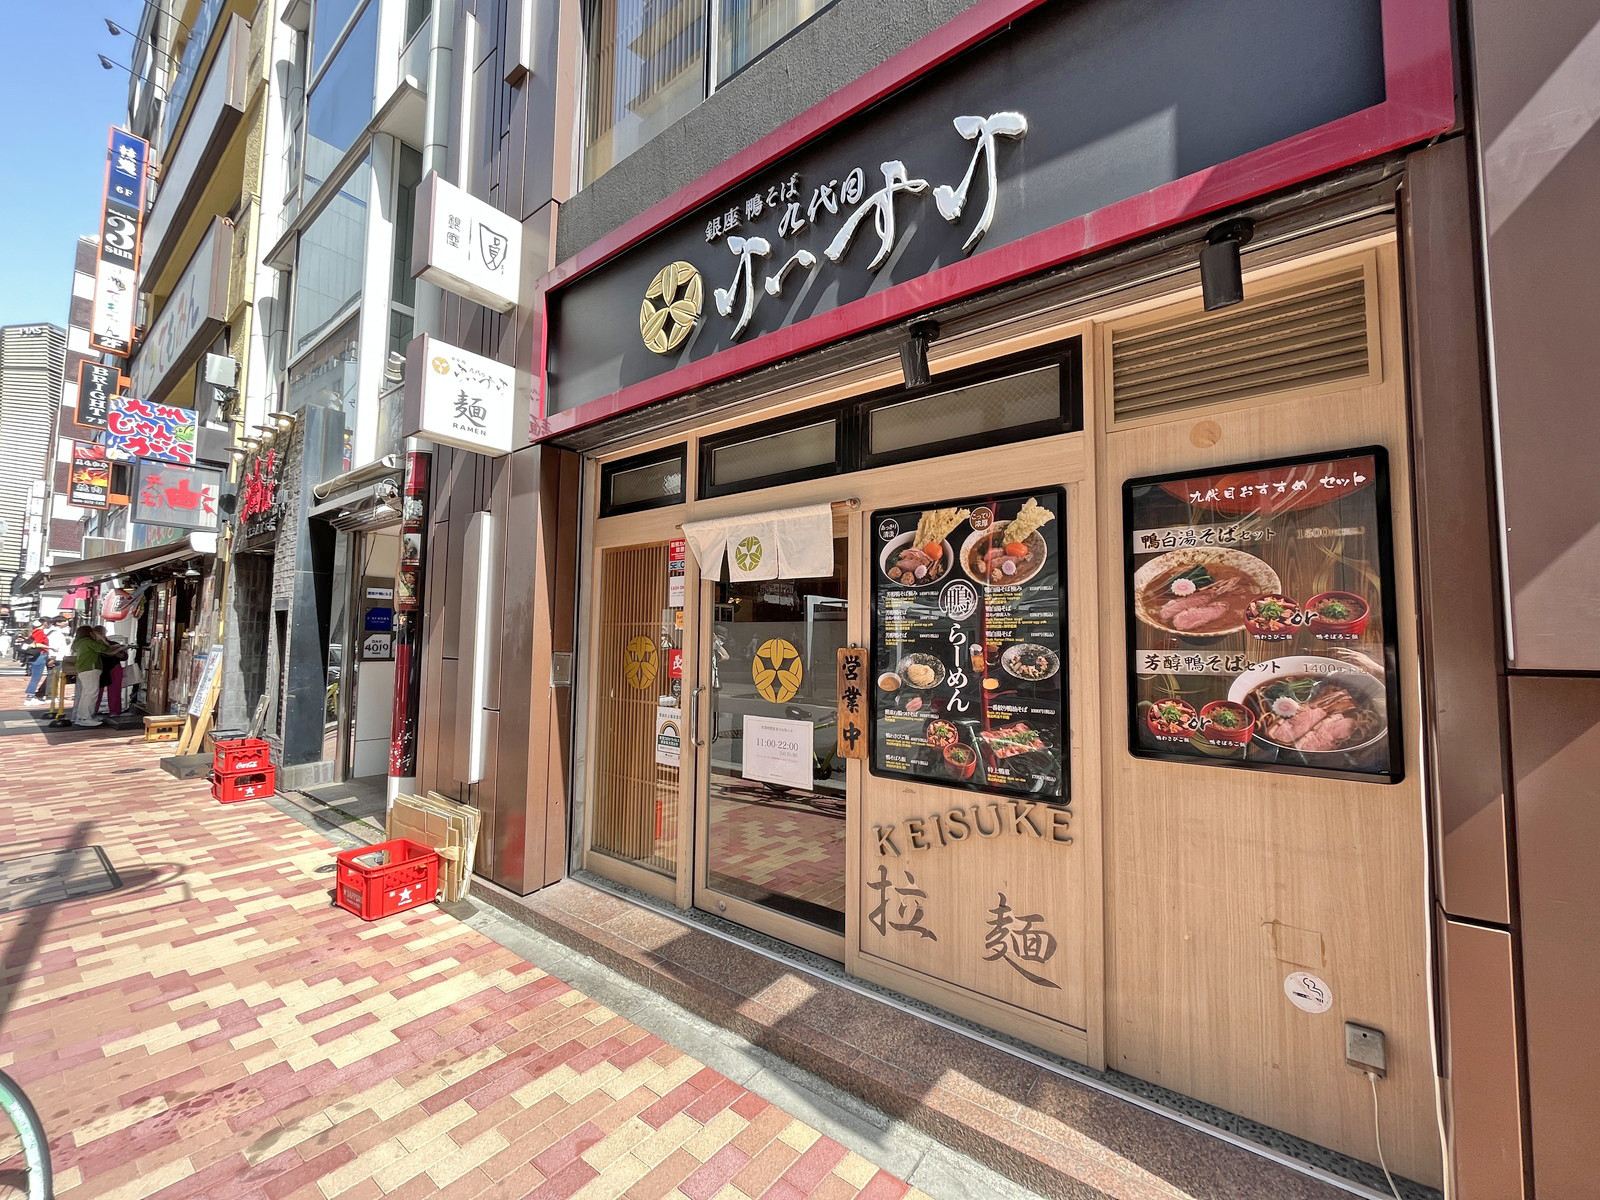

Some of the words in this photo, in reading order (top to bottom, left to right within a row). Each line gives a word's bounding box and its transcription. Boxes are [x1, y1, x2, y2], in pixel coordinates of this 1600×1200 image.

[116, 186, 133, 197] 6F
[778, 167, 867, 238] 九代目
[705, 206, 743, 242] 銀座
[745, 172, 800, 221] 鴨そば
[105, 216, 135, 250] 3
[105, 245, 133, 260] sun
[101, 336, 124, 349] 2F
[88, 366, 108, 417] BRIGHT
[123, 398, 189, 424] 九州
[453, 389, 487, 428] 麺
[453, 423, 487, 436] RAMEN
[1319, 472, 1367, 490] セット
[1290, 610, 1318, 626] or
[365, 643, 389, 652] 4019
[946, 623, 969, 712] らーめん
[842, 655, 862, 751] 営業中
[1187, 717, 1212, 731] or
[871, 801, 1074, 857] KEISUKE
